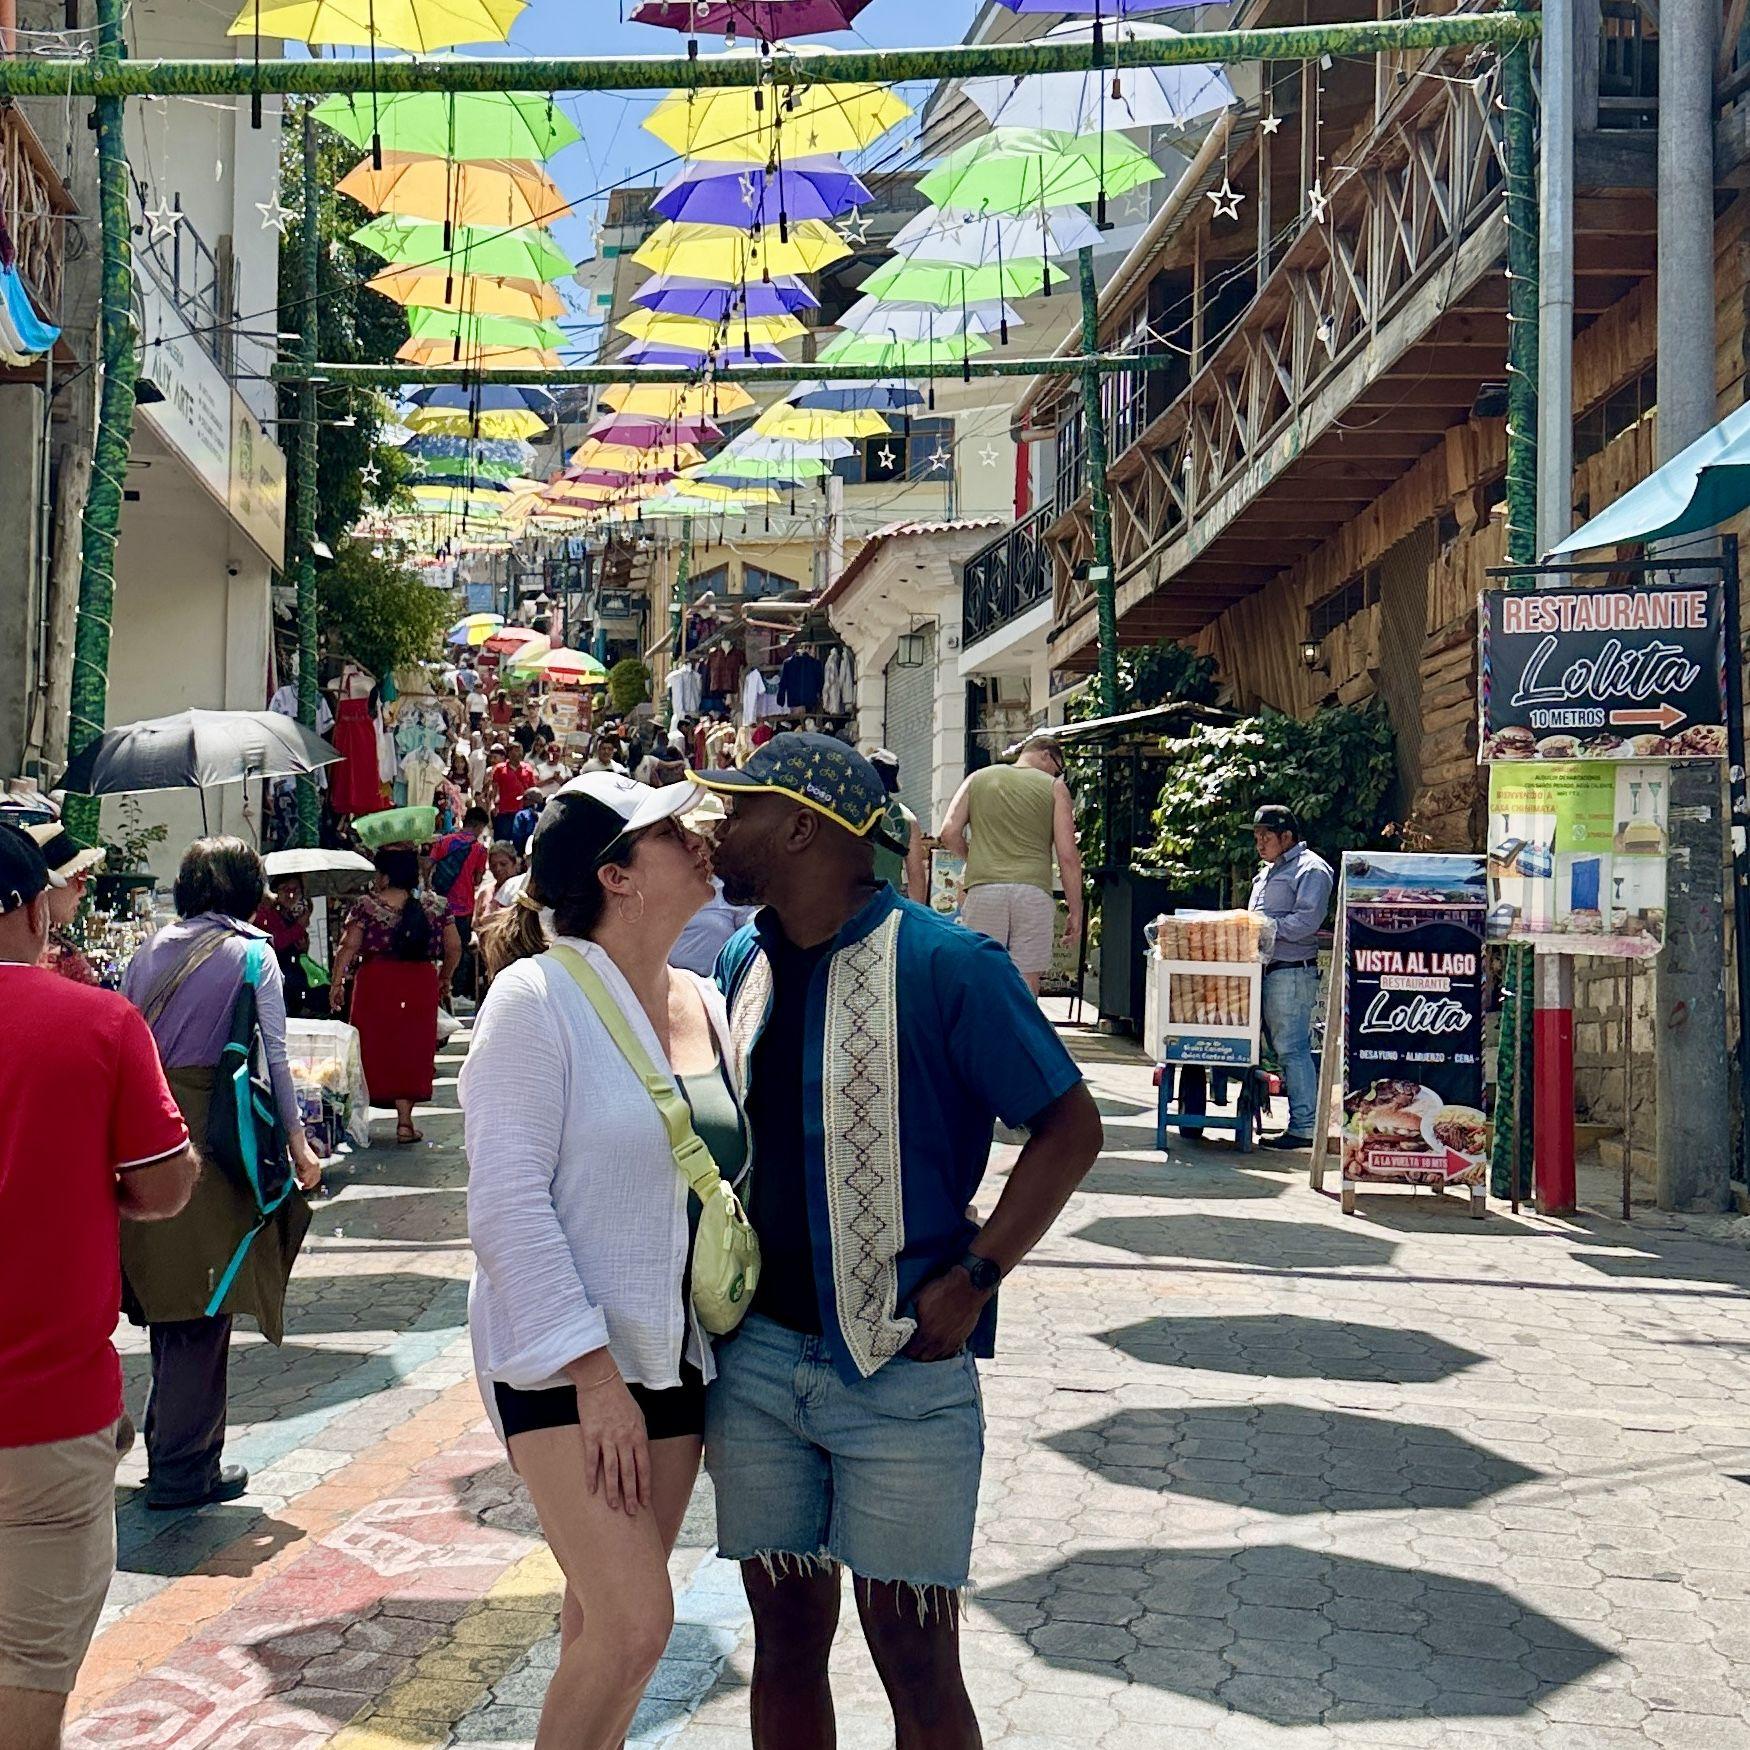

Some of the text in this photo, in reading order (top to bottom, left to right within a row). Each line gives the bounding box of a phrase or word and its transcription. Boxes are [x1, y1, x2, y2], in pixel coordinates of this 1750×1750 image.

[1503, 591, 1708, 634] RESTAURANTE
[1510, 634, 1701, 707] Lolita
[1530, 709, 1605, 727] 10 METROS
[1354, 950, 1476, 975] VISTA AL LAGO
[1382, 976, 1448, 990] RESTAURANTE
[1359, 990, 1473, 1035] Lolita
